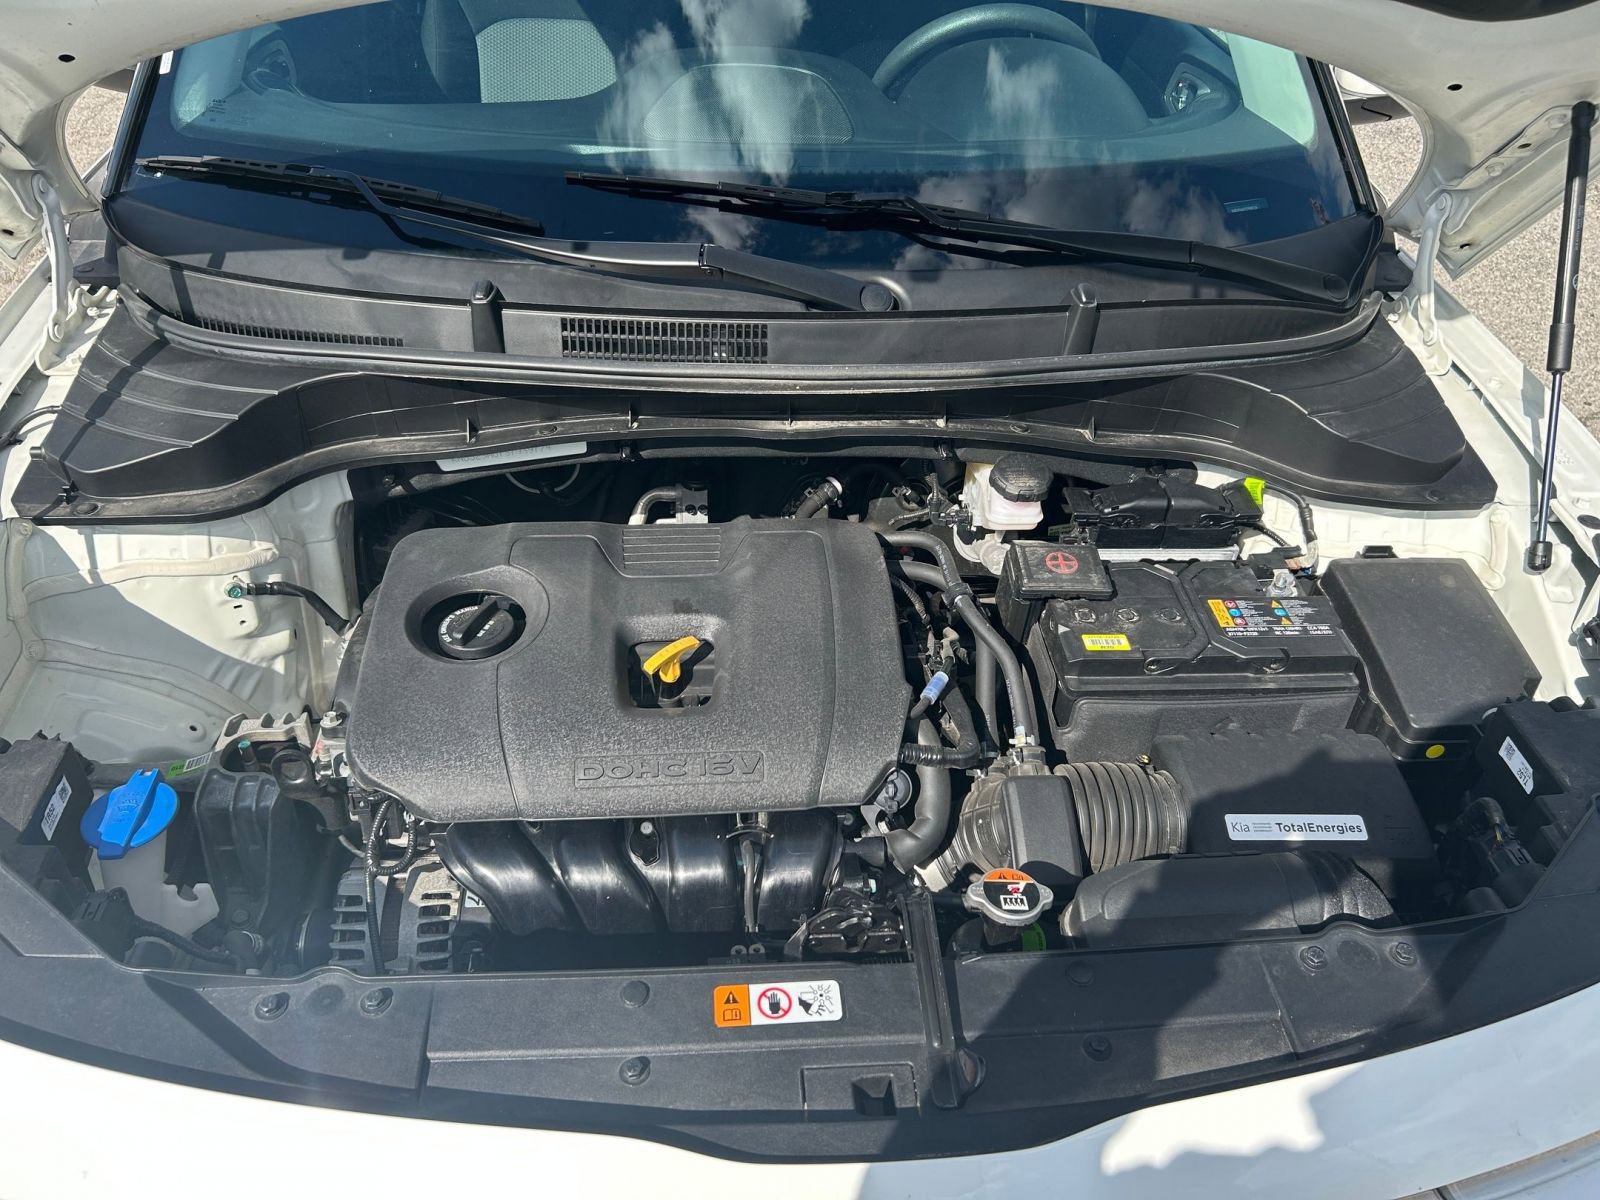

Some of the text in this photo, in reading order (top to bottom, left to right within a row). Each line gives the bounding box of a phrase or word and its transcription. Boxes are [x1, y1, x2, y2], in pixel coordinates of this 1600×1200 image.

[577, 755, 762, 781] DOHC 16V
[1230, 821, 1363, 835] Kia TotalEnergies
